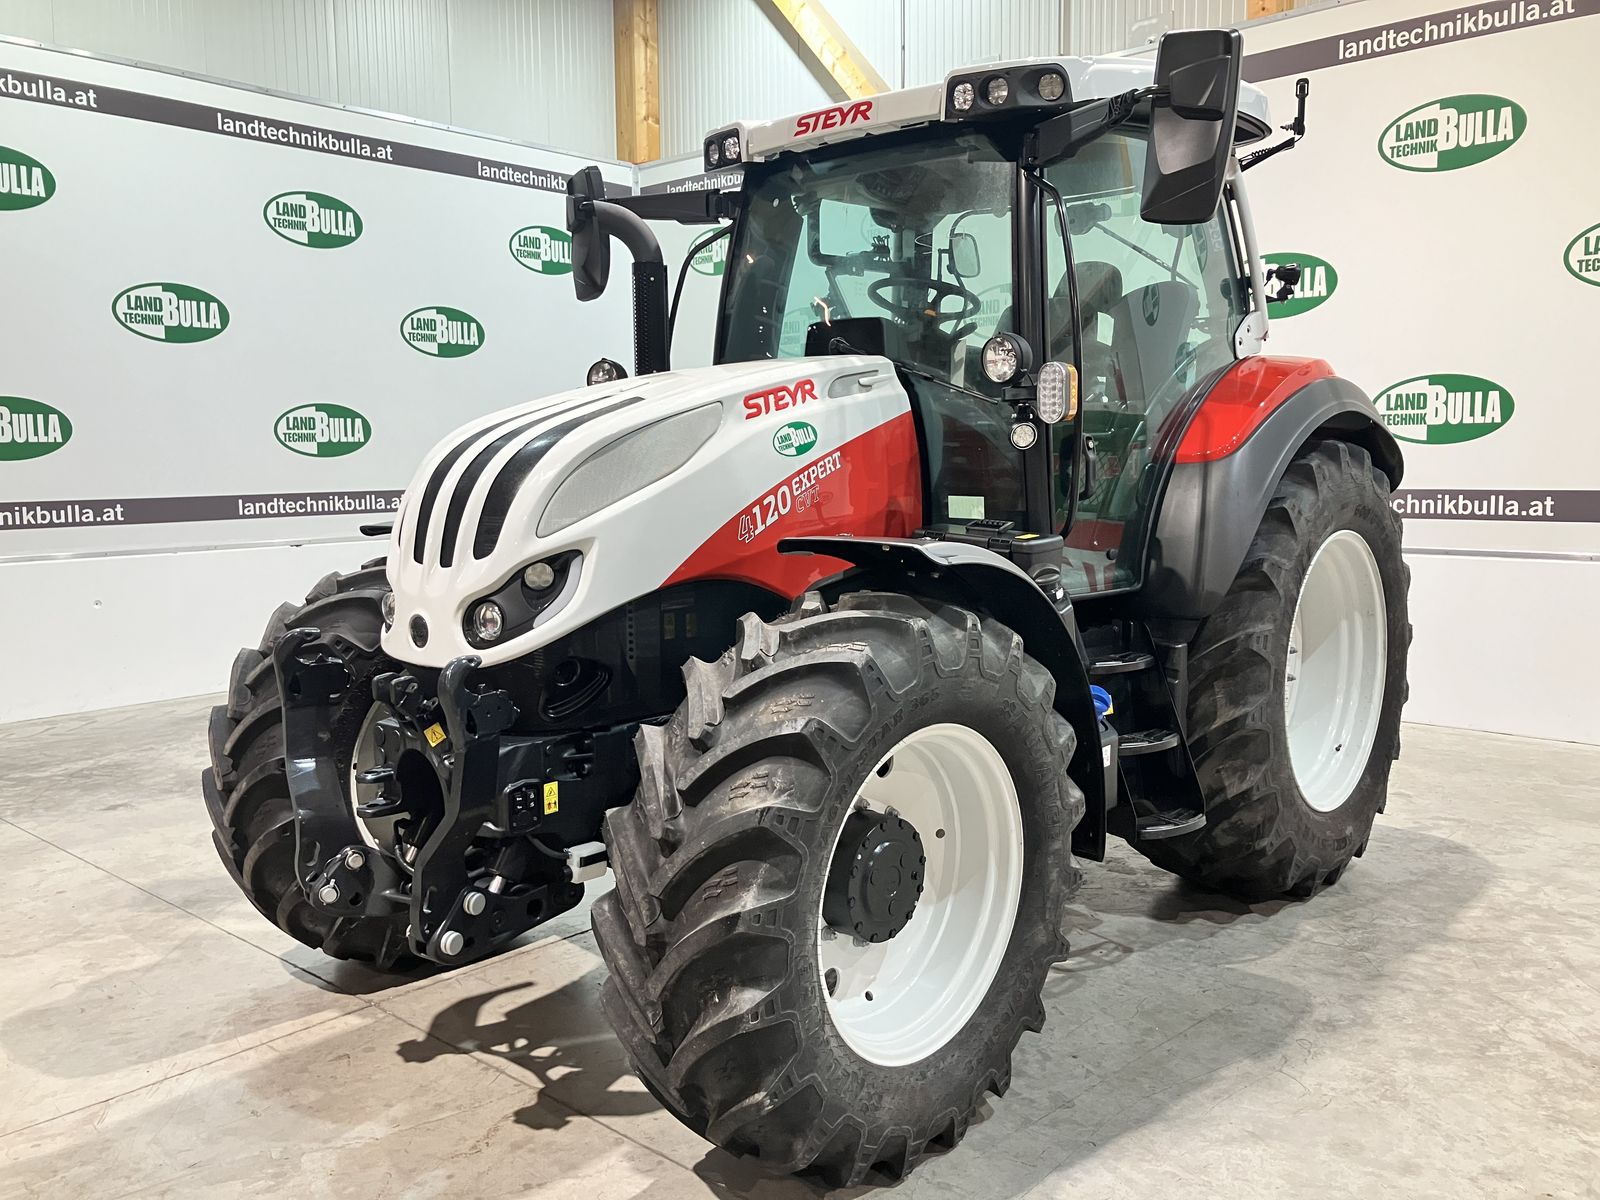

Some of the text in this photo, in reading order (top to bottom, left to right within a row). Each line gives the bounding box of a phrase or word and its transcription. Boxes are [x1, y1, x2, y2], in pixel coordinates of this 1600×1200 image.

[1338, 0, 1576, 60] landtechnikbulla.at
[794, 101, 873, 137] STEYR
[1395, 106, 1514, 152] LAND BULLA
[217, 112, 393, 160] landtechnikbulla.at
[1389, 139, 1438, 159] TECHNIK
[272, 217, 307, 231] TECHNIK
[275, 199, 356, 237] LAND BULLA
[516, 249, 541, 260] TECHNIK
[518, 233, 572, 264] LAND BULL
[123, 312, 164, 325] TECHNIK
[126, 291, 221, 329] LAND BULLA
[408, 332, 437, 343] TECHNIK
[411, 314, 479, 345] LAND BULLA
[743, 378, 818, 420] STEYR
[1385, 384, 1501, 425] LAND BULLA
[283, 432, 317, 443] TECHNIK
[286, 411, 364, 443] LAND BULLA
[777, 433, 792, 444] LAND
[792, 451, 842, 496] EXPERT
[795, 484, 820, 513] CVT
